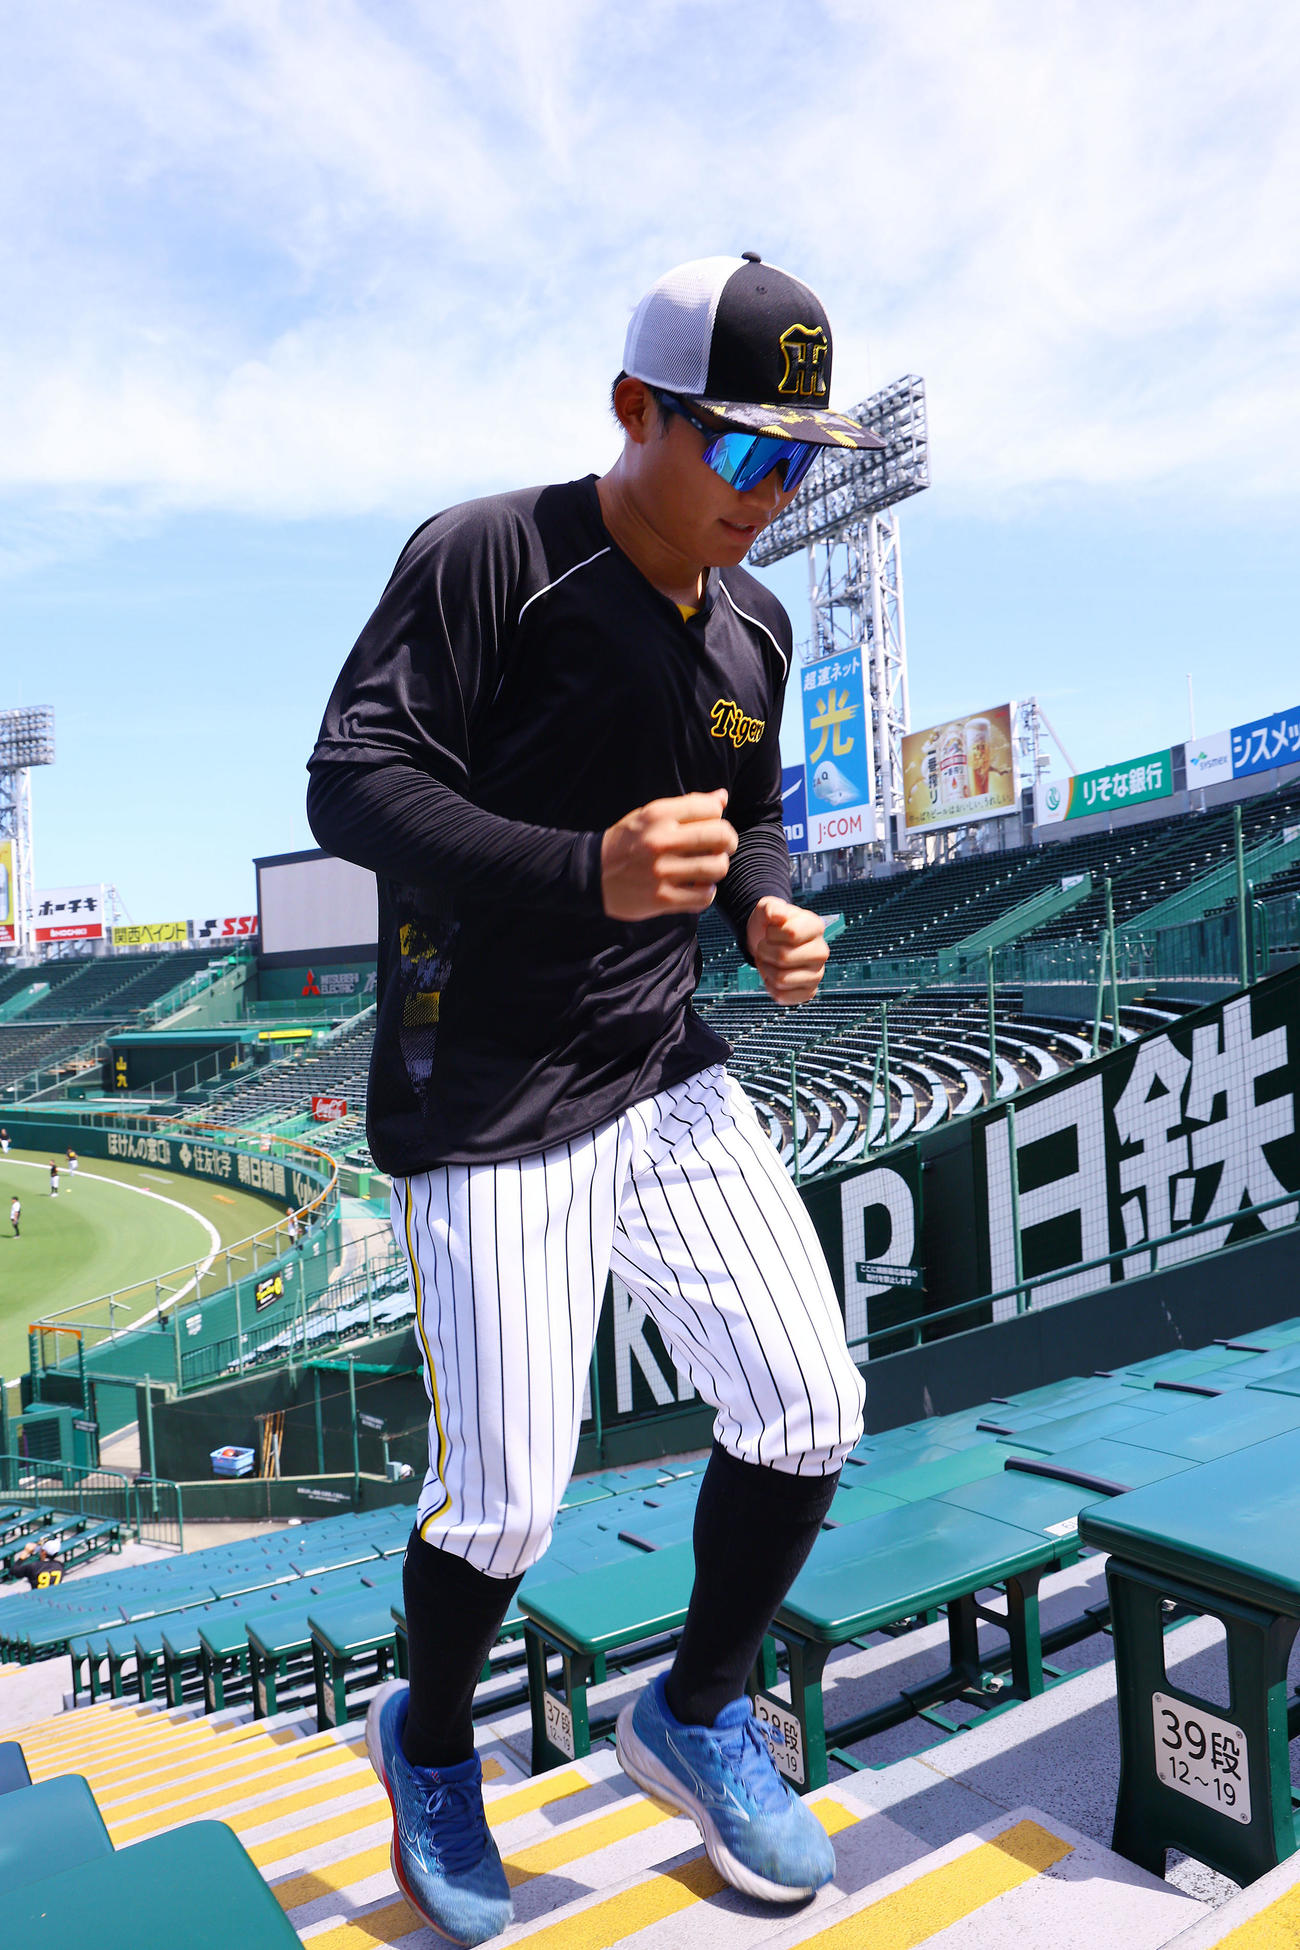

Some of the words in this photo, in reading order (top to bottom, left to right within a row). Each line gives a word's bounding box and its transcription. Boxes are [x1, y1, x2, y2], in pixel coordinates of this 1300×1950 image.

[804, 656, 860, 691] 超速ネット
[710, 698, 766, 748] Tiger
[810, 688, 861, 763] 光
[927, 749, 938, 804] 一番搾り
[1083, 761, 1163, 805] りそな銀行
[817, 814, 862, 844] J:COM
[38, 897, 98, 916] ホーチキ
[115, 1056, 128, 1088] 山九
[107, 1133, 171, 1165] ほけんの窓口
[193, 1145, 232, 1178] 住友化学
[237, 1154, 287, 1197] 朝日新聞
[37, 1570, 62, 1589] 97
[547, 1700, 571, 1738] 37段
[1161, 1709, 1242, 1781] 39段
[1169, 1756, 1236, 1806] 12~19
